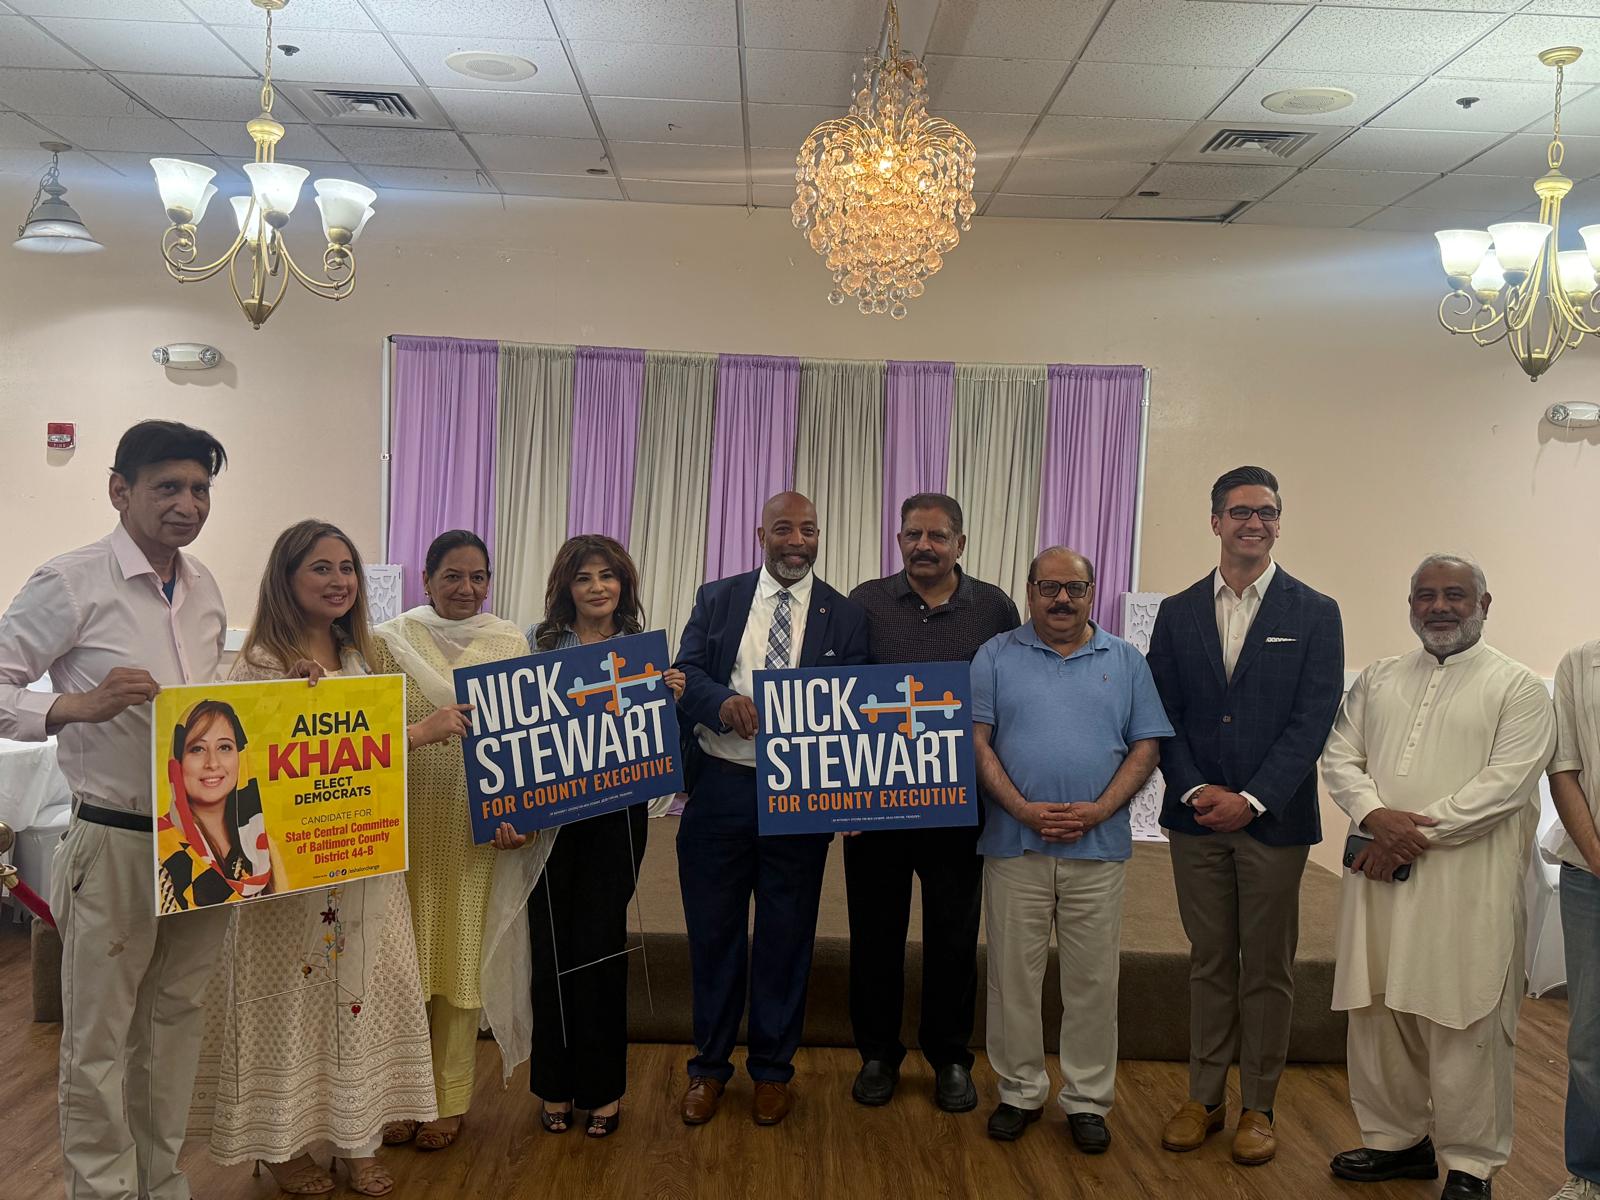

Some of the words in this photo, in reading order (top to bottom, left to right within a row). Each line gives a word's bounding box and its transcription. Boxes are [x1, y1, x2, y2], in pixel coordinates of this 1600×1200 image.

[467, 661, 570, 737] NICK
[763, 677, 861, 735] NICK
[291, 710, 370, 738] AISHA
[269, 733, 391, 781] KHAN
[475, 699, 667, 795] STEWART
[766, 729, 964, 791] STEWART
[294, 786, 371, 806] DEMOCRATS
[314, 776, 353, 790] ELECT
[481, 794, 517, 820] FOR
[522, 777, 589, 810] COUNTY
[594, 756, 674, 793] EXECUTIVE
[768, 794, 801, 813] FOR
[807, 791, 873, 812] COUNTY
[880, 786, 968, 808] EXECUTIVE
[285, 830, 311, 843] State
[314, 824, 348, 839] Central
[351, 818, 400, 833] Committee
[301, 811, 352, 826] CANDIDATE
[354, 808, 372, 818] FOR
[297, 843, 307, 854] of
[310, 838, 355, 853] Baltimore
[358, 831, 390, 845] County
[314, 849, 349, 865] District
[352, 845, 374, 858] 44-B
